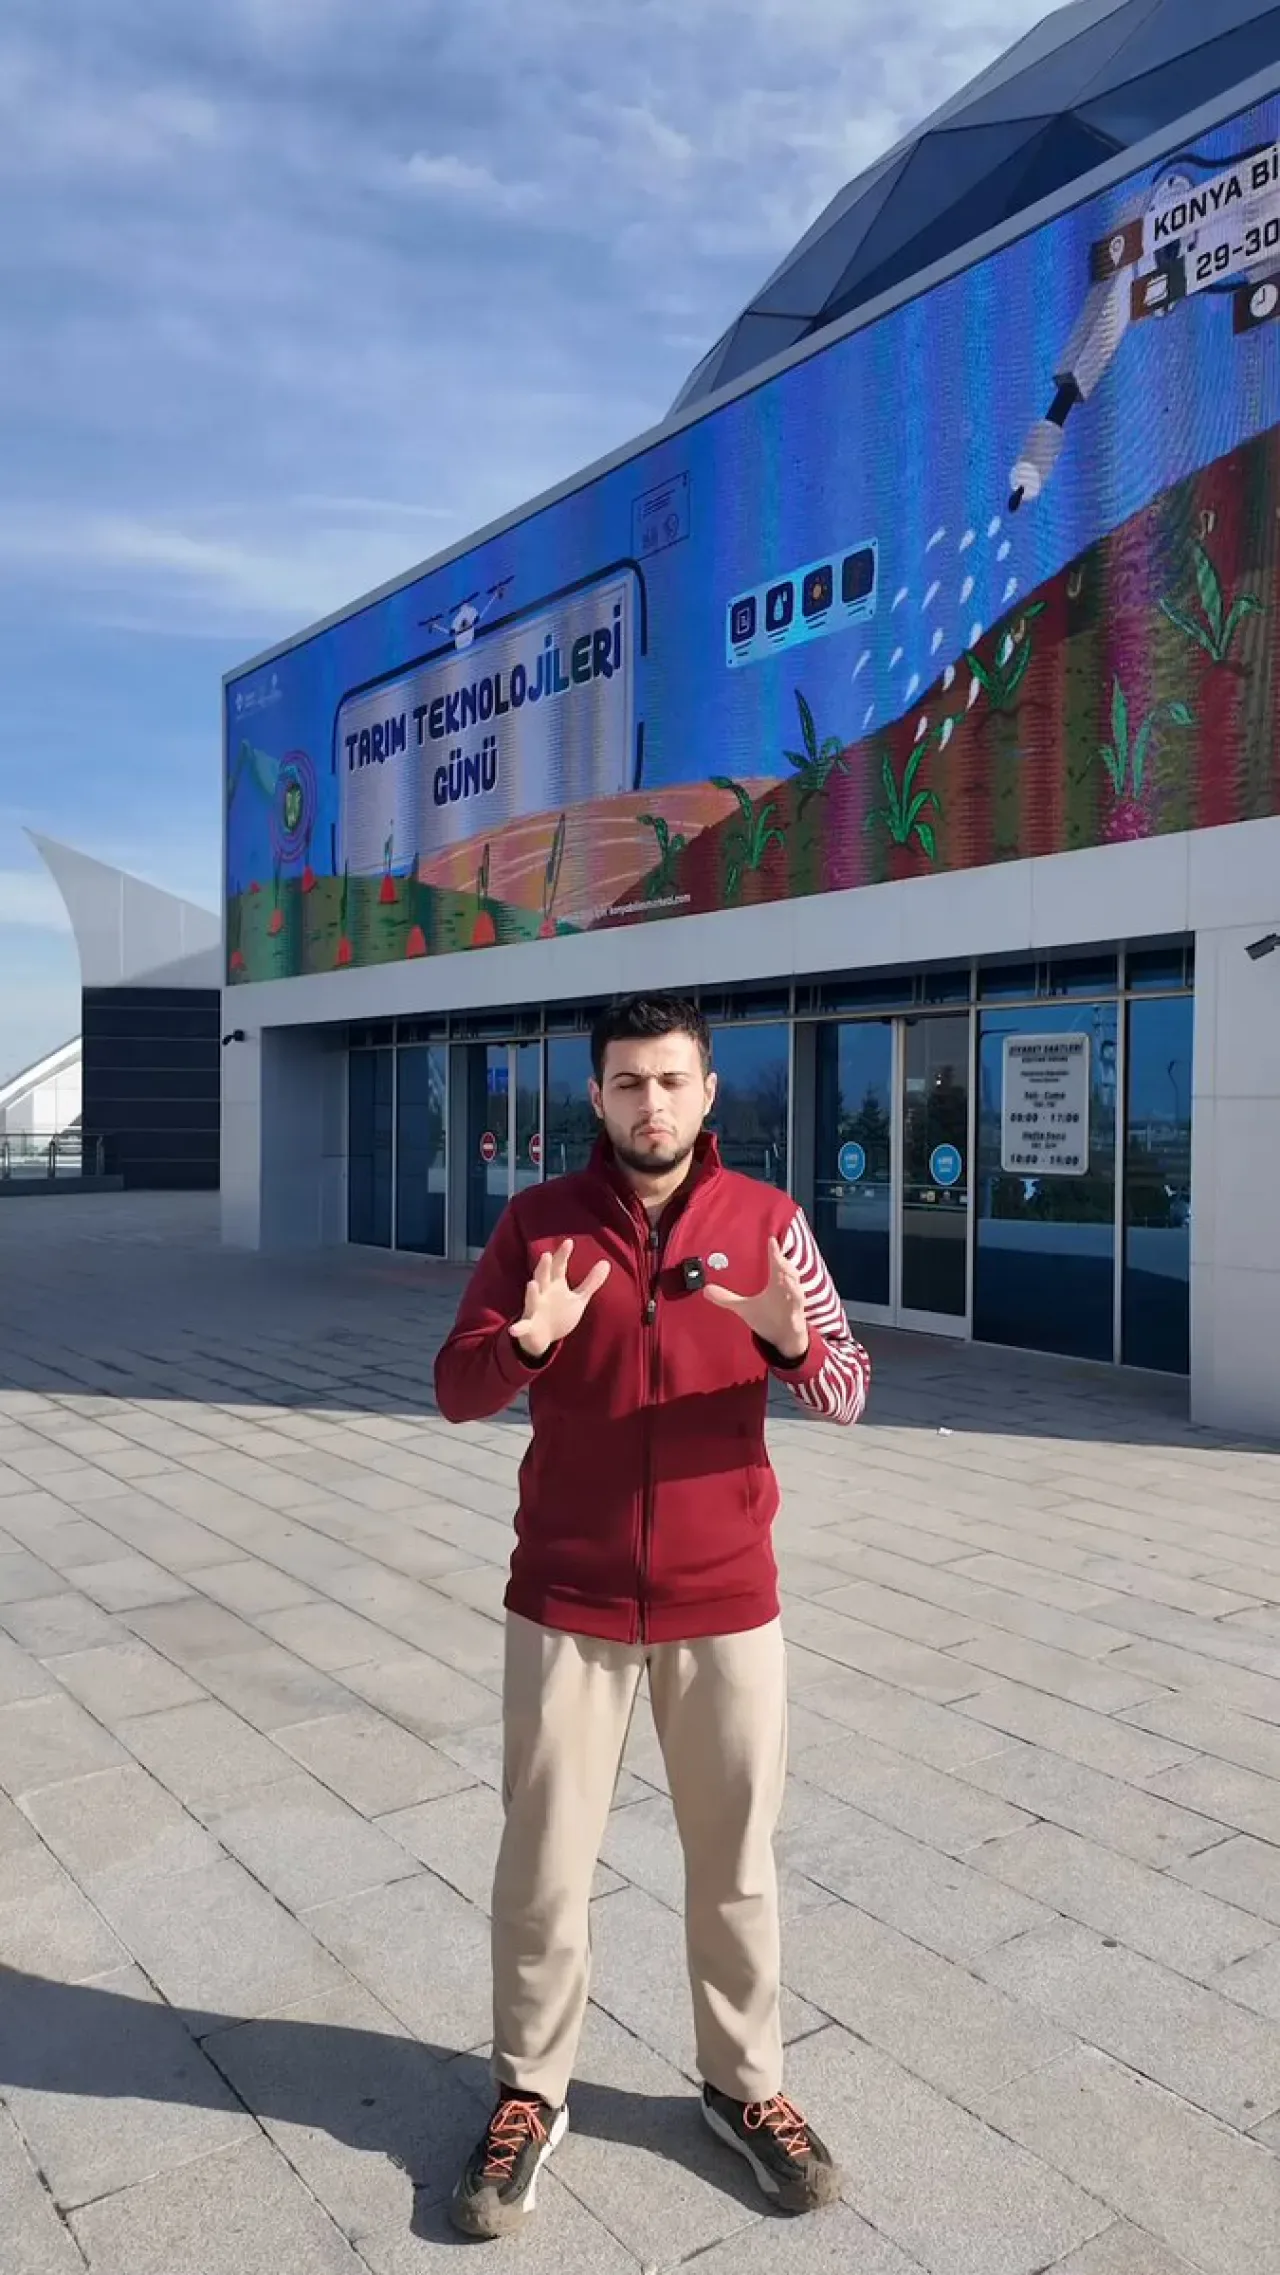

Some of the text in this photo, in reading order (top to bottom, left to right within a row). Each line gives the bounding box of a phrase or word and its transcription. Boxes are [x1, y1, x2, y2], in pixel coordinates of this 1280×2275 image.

[1154, 175, 1243, 242] KONYA
[1196, 217, 1279, 281] 29-30
[345, 603, 622, 771] TARIM TEKNOLOJİLERİ
[433, 736, 498, 807] GÜNÜ
